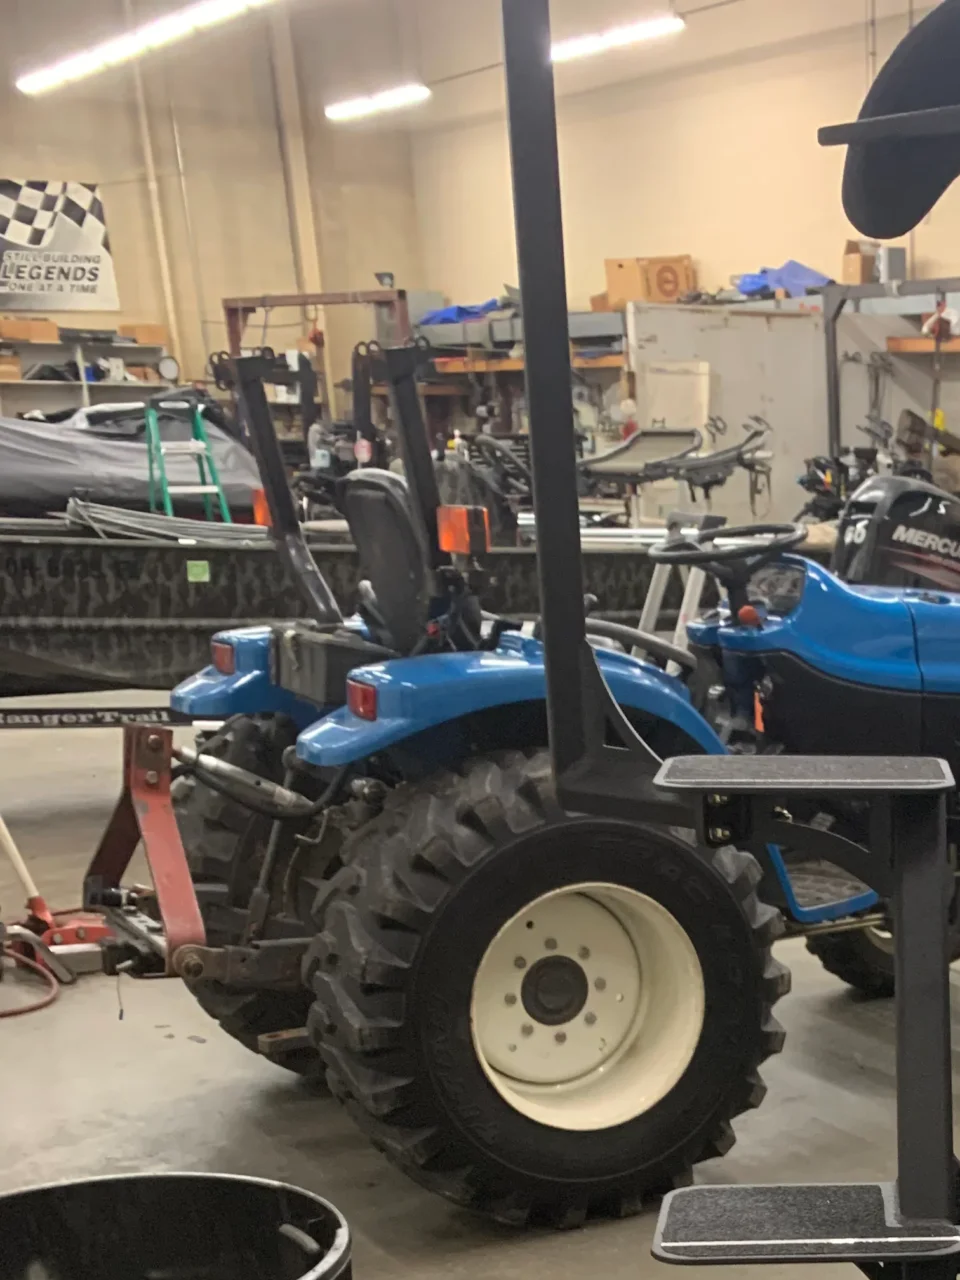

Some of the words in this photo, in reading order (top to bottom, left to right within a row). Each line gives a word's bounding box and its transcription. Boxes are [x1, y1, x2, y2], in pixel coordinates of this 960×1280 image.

[5, 252, 38, 262] STILL
[43, 254, 101, 264] BUILDING
[1, 264, 100, 282] LEGENDS
[8, 282, 33, 292] ONE
[39, 283, 53, 292] AT
[57, 284, 64, 292] A
[69, 283, 98, 294] TIME
[96, 710, 171, 724] Trail
